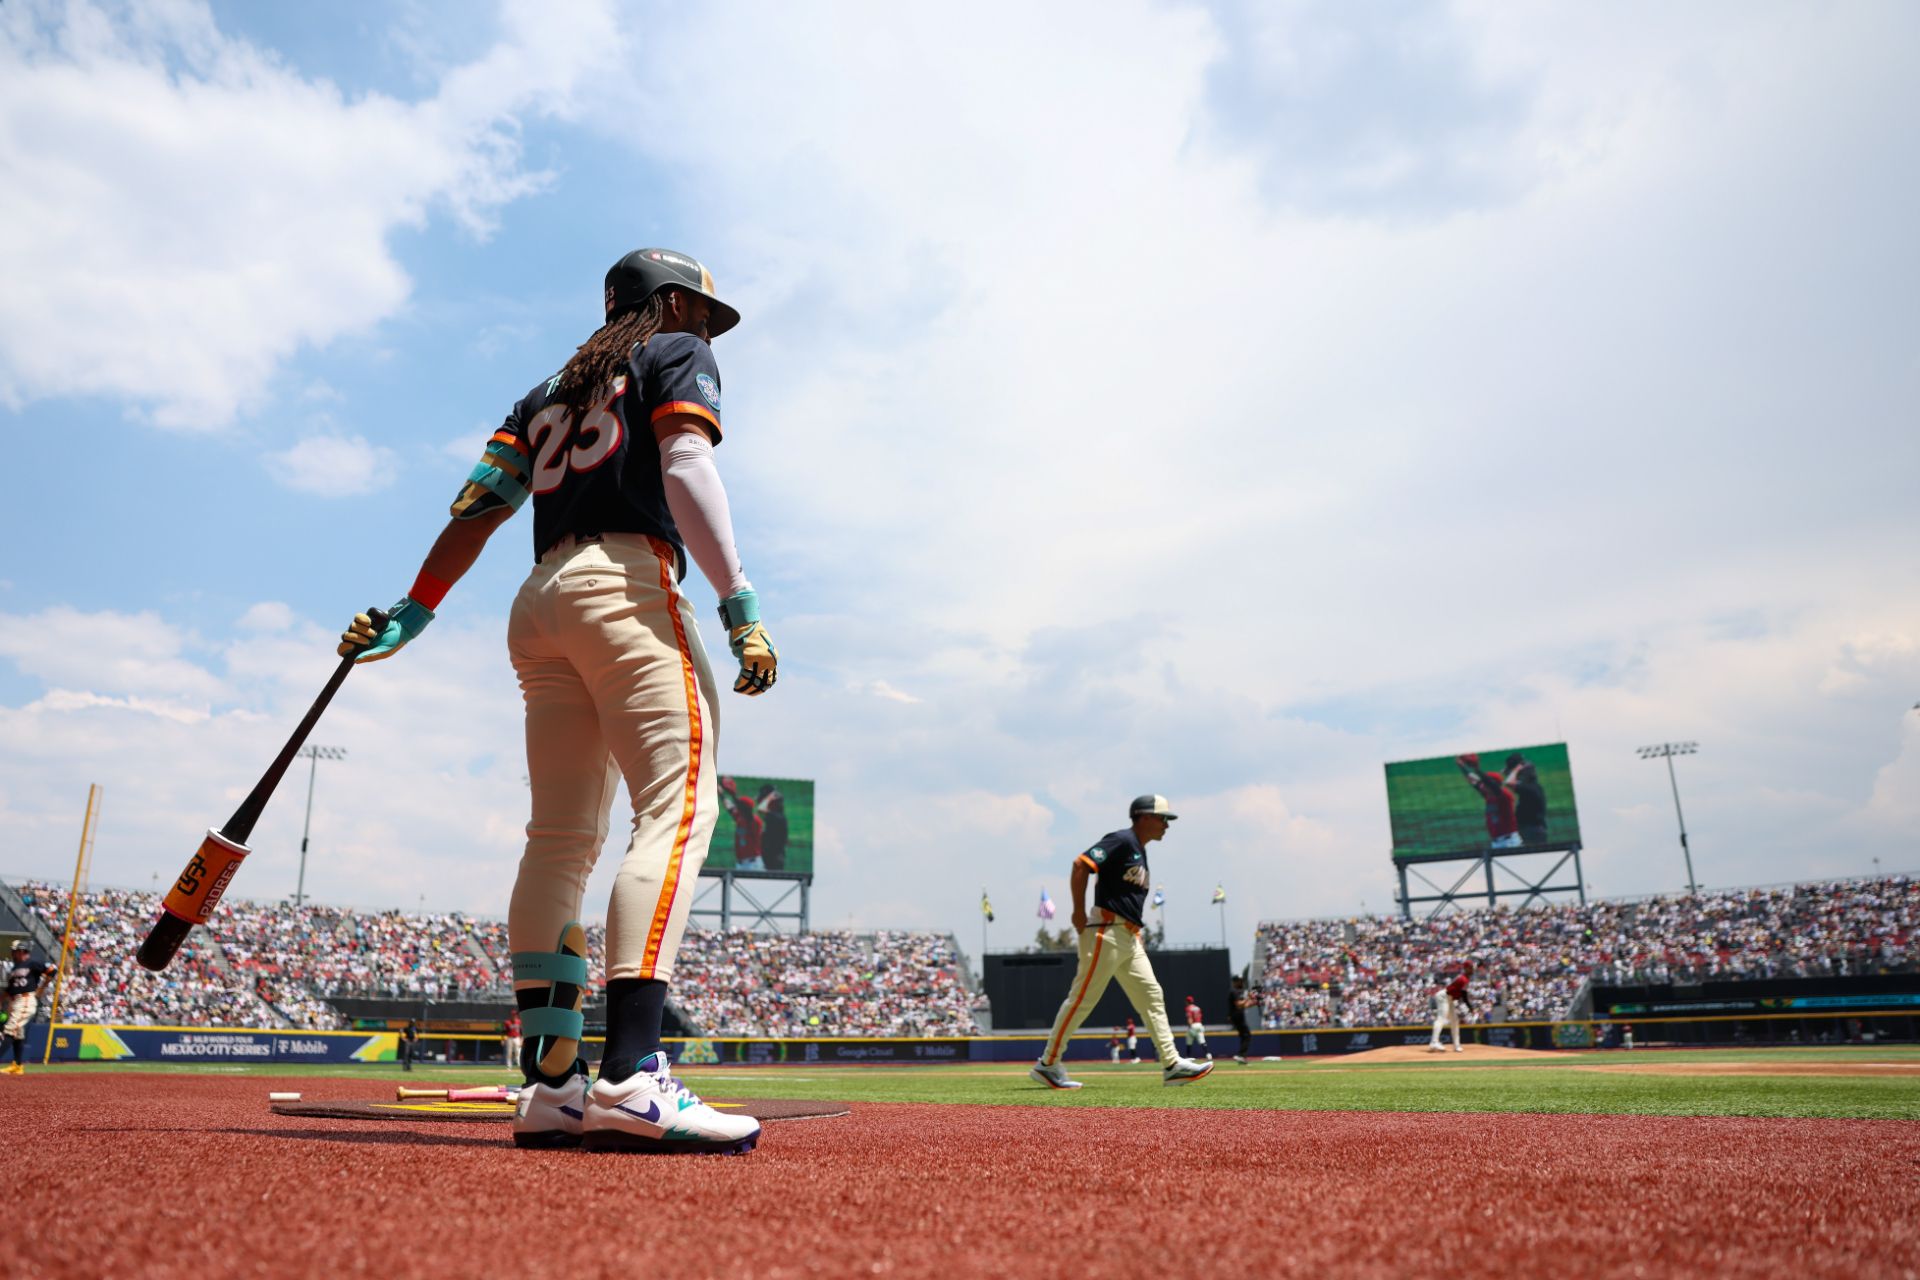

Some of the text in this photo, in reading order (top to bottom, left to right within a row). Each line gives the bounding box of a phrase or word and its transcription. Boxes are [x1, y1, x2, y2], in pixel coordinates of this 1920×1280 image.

[199, 860, 241, 918] PADRES
[161, 1043, 270, 1056] MEXICO CITY SERIES
[290, 1040, 328, 1054] Mobile
[837, 1047, 866, 1058] Google
